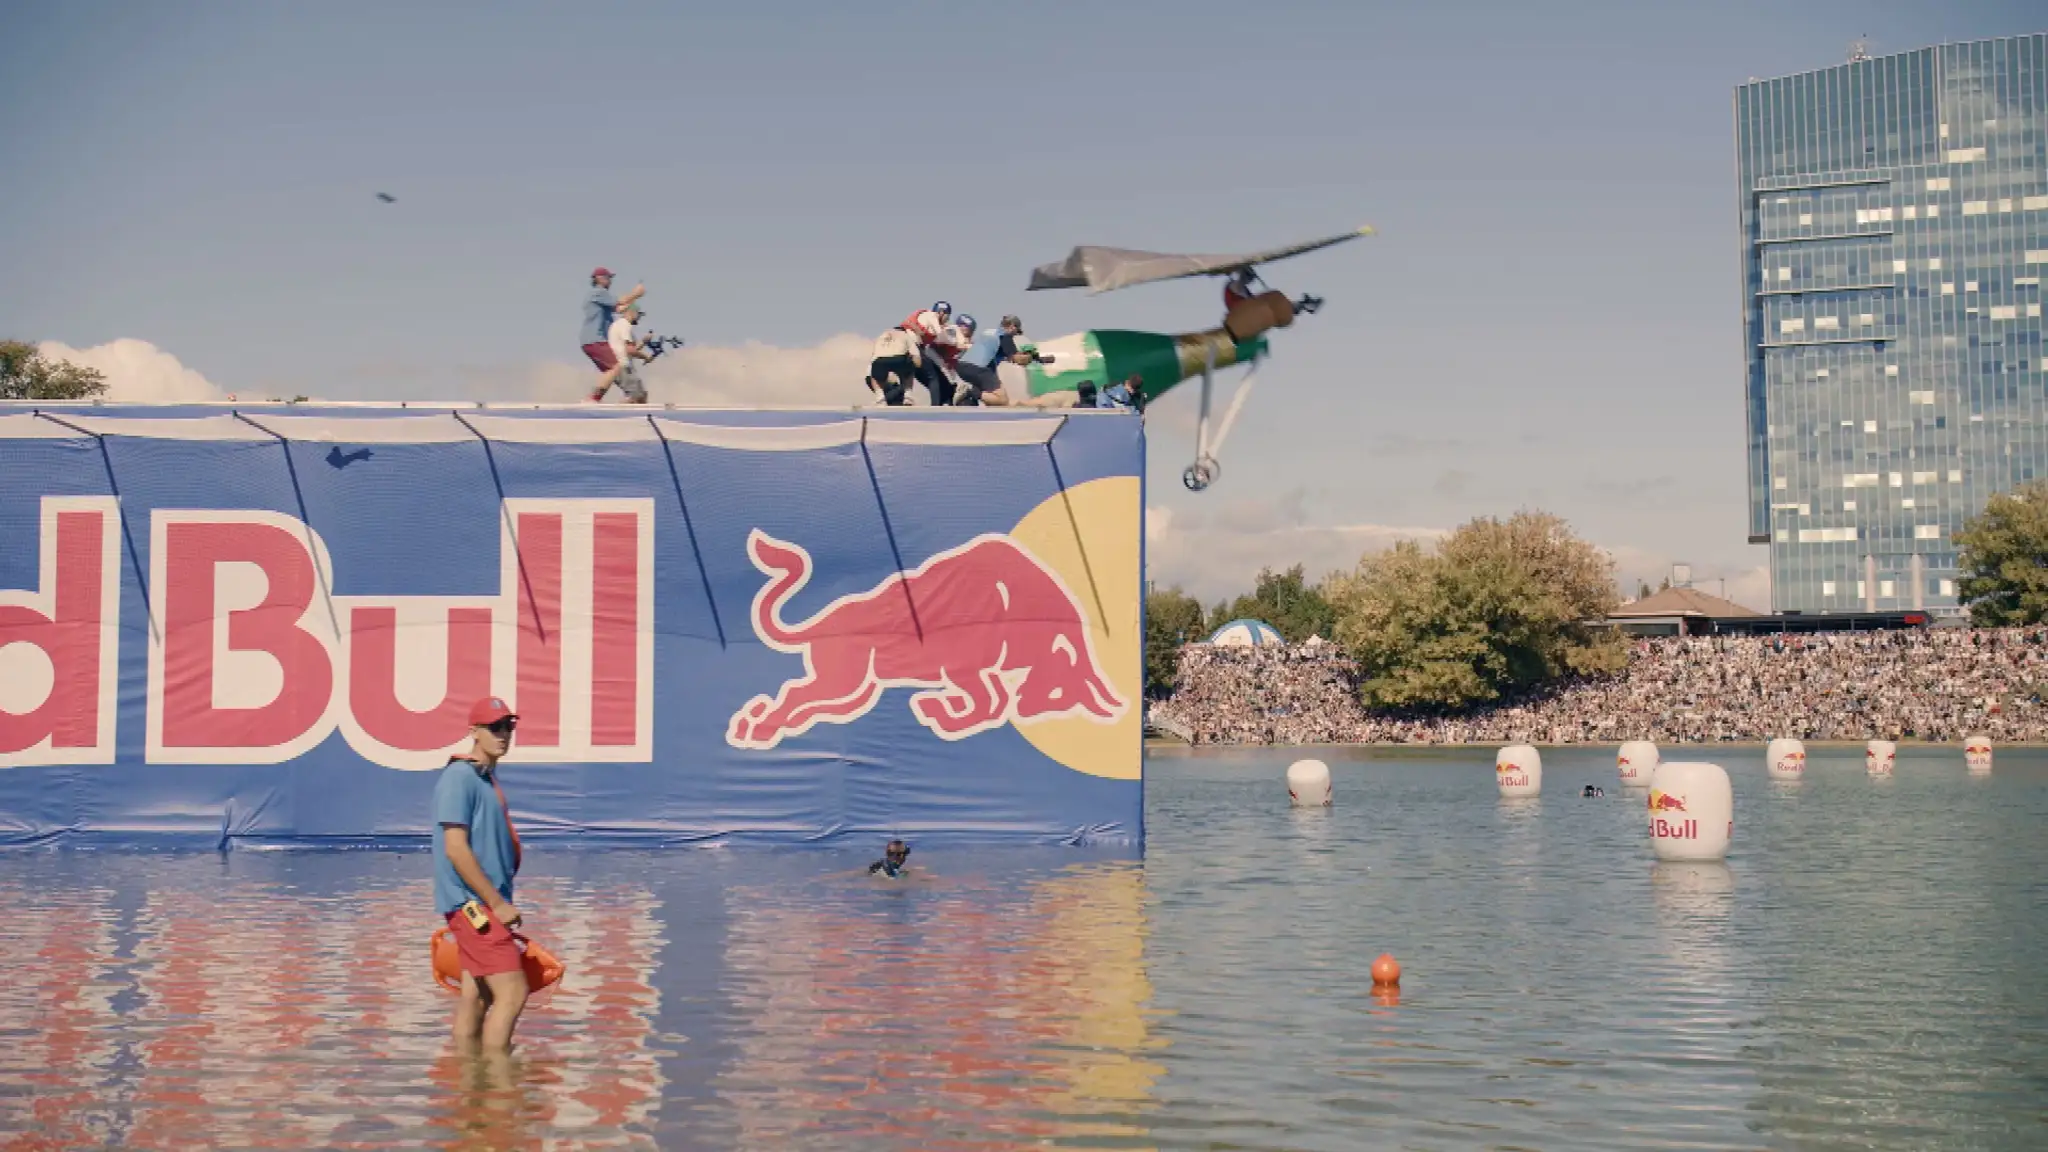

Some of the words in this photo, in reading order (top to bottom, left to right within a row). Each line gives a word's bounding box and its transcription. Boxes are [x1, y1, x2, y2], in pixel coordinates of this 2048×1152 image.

[155, 505, 646, 758] Bull
[1505, 774, 1529, 787] Bull
[1656, 818, 1697, 840] Bull
